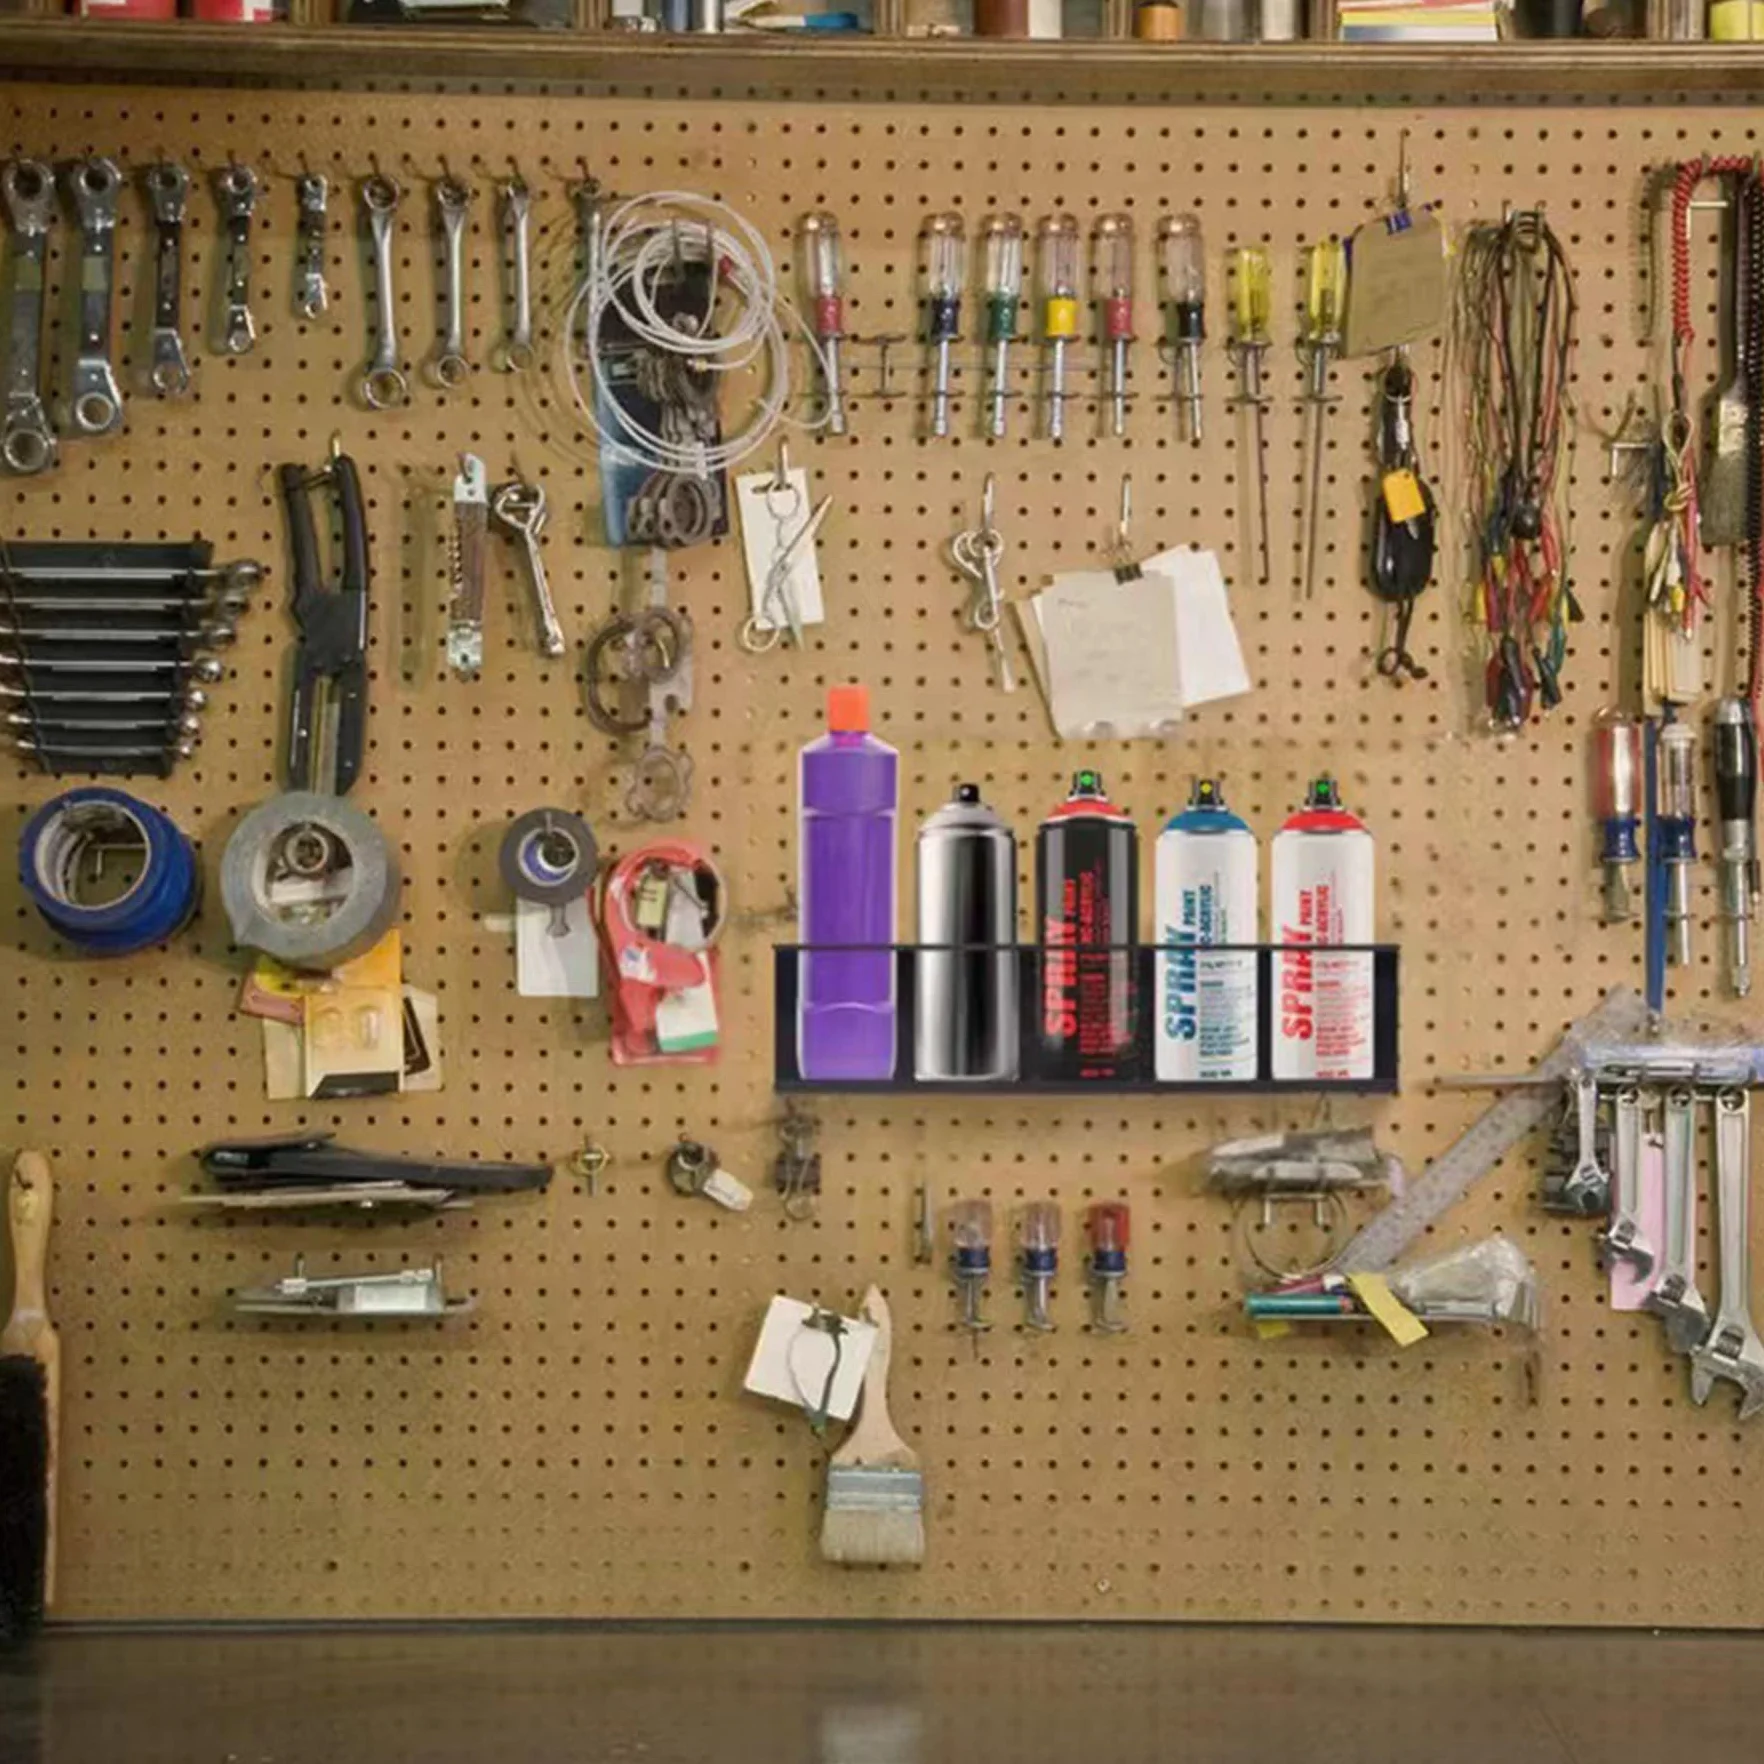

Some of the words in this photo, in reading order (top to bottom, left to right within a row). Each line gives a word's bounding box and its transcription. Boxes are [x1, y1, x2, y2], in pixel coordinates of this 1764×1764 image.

[1045, 916, 1077, 1037] SPRAY
[1165, 924, 1196, 1040] SPRAY
[1182, 890, 1196, 926] PAINT
[1198, 885, 1212, 951] C-ACRYLIC
[1282, 924, 1312, 1040] SPRAY
[1300, 890, 1312, 926] PAINT
[1316, 885, 1329, 951] C-ACRYLIC
